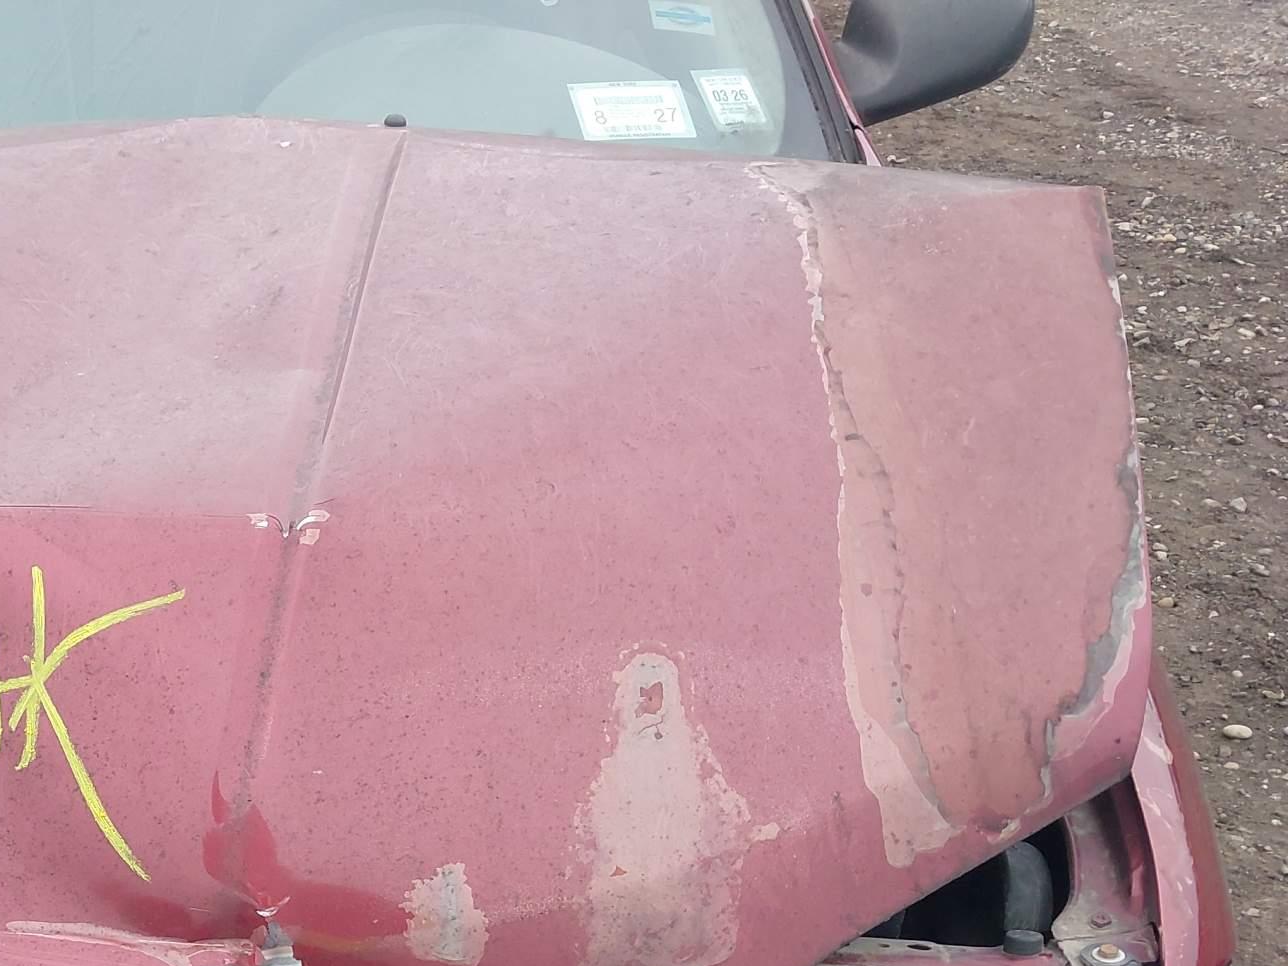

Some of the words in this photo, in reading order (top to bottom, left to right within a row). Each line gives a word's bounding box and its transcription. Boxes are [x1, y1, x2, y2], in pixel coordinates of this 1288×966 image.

[712, 89, 728, 102] 03
[731, 89, 748, 101] 26
[594, 110, 607, 125] 8
[654, 107, 677, 123] 27
